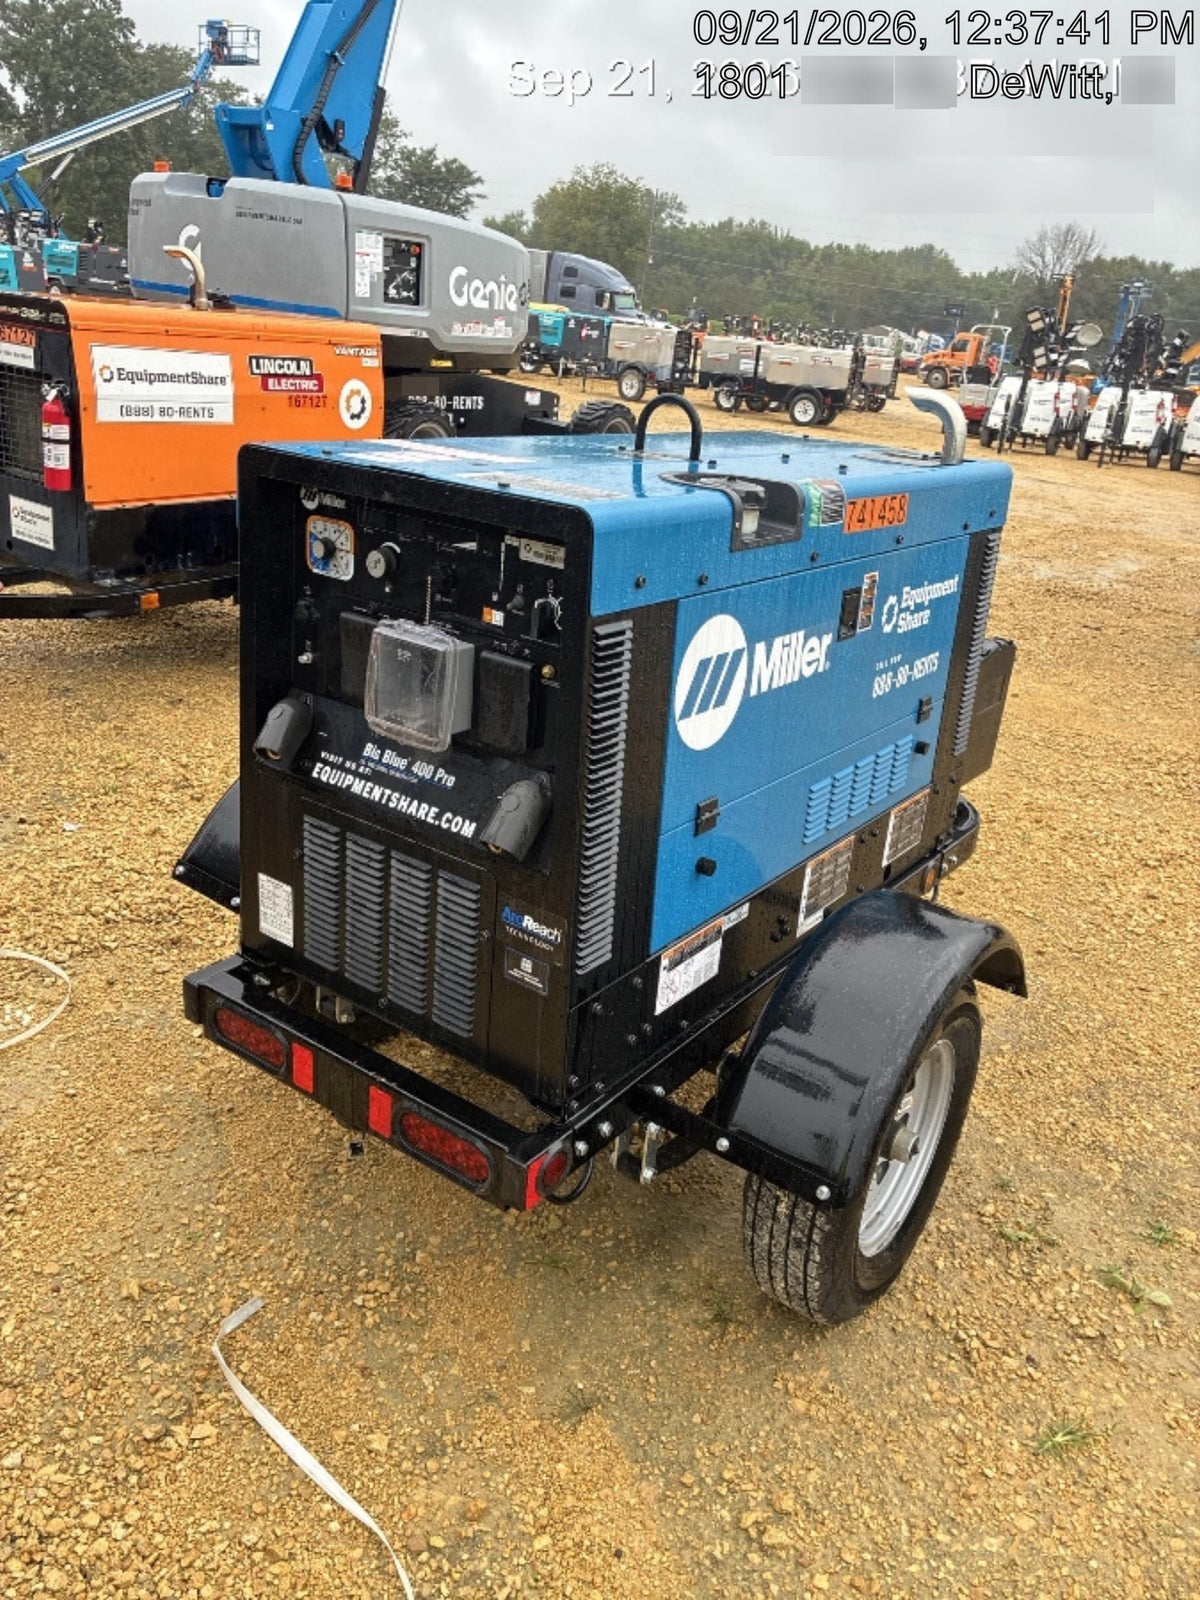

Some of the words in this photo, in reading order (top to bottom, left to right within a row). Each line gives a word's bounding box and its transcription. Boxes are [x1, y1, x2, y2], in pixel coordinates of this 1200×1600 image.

[449, 266, 518, 312] Genie
[116, 367, 228, 387] EquipmentShare
[251, 358, 312, 376] LINCOLN
[267, 378, 319, 391] ELECTRIC
[288, 395, 328, 408] 167127
[900, 574, 960, 611] Equipment
[897, 609, 931, 634] Share
[750, 629, 833, 698] Miller
[311, 761, 478, 839] EQUIPMENTSHARE.COM
[502, 905, 561, 943] ArcReach
